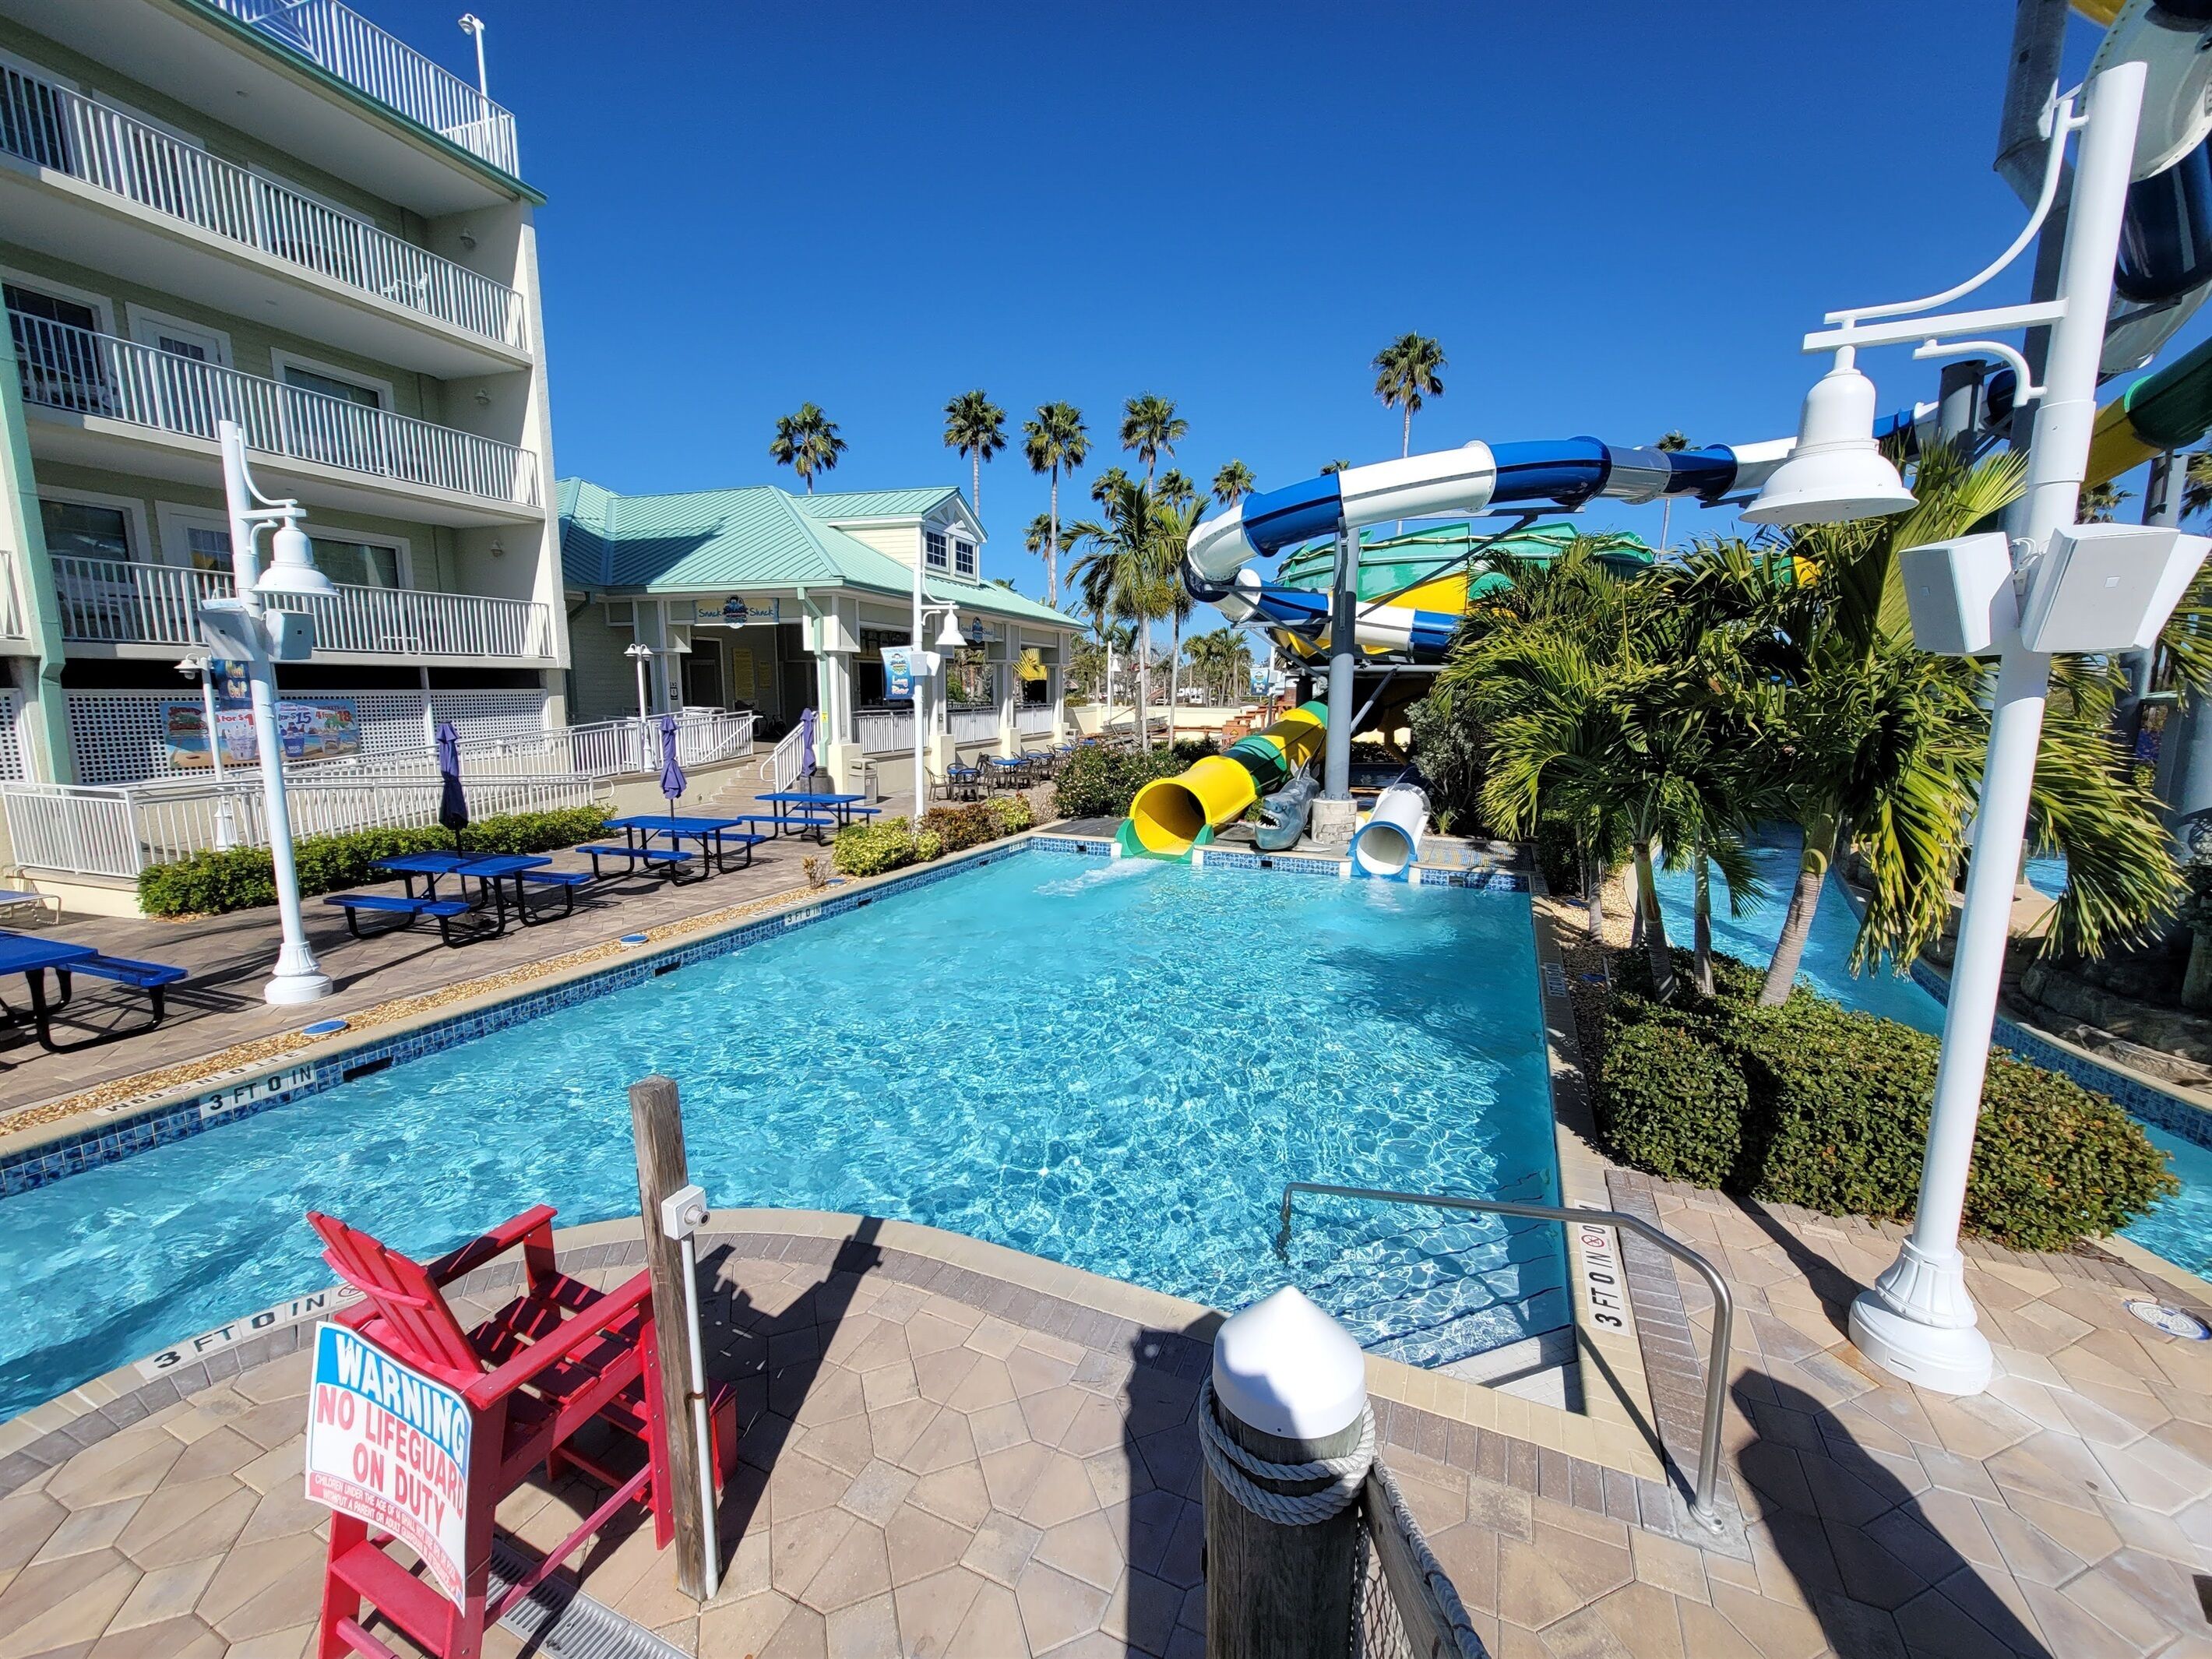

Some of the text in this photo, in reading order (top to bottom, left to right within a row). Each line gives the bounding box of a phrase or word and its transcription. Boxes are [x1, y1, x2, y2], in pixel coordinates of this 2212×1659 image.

[699, 608, 722, 618] Snack
[750, 606, 773, 616] Shack
[891, 685, 909, 694] River
[892, 675, 908, 687] Lazy
[238, 713, 255, 726] $1
[291, 711, 312, 724] $15
[787, 914, 793, 923] 3
[795, 910, 803, 921] FT
[813, 905, 821, 915] IN
[210, 1094, 224, 1111] 3
[234, 1082, 258, 1104] FT
[292, 1065, 312, 1085] IN
[1585, 1250, 1613, 1269] IN
[1590, 1287, 1621, 1310] FT
[1594, 1312, 1622, 1326] 3
[154, 1351, 181, 1368] 3
[193, 1324, 235, 1352] FT
[292, 1293, 325, 1316] IN
[336, 1333, 465, 1469] WARNING
[316, 1384, 463, 1521] NO LIFEGUARD
[315, 1474, 343, 1493] CHILDREN
[343, 1483, 363, 1501] UNDER
[364, 1492, 375, 1506] THE
[376, 1498, 386, 1513] AGE
[387, 1504, 396, 1516] OF
[352, 1442, 446, 1538] ON DUTY
[322, 1488, 347, 1509] WITHOUT
[347, 1499, 353, 1510] A
[354, 1500, 375, 1520] PARENT
[375, 1511, 384, 1524] OR
[385, 1516, 400, 1534] ADULT
